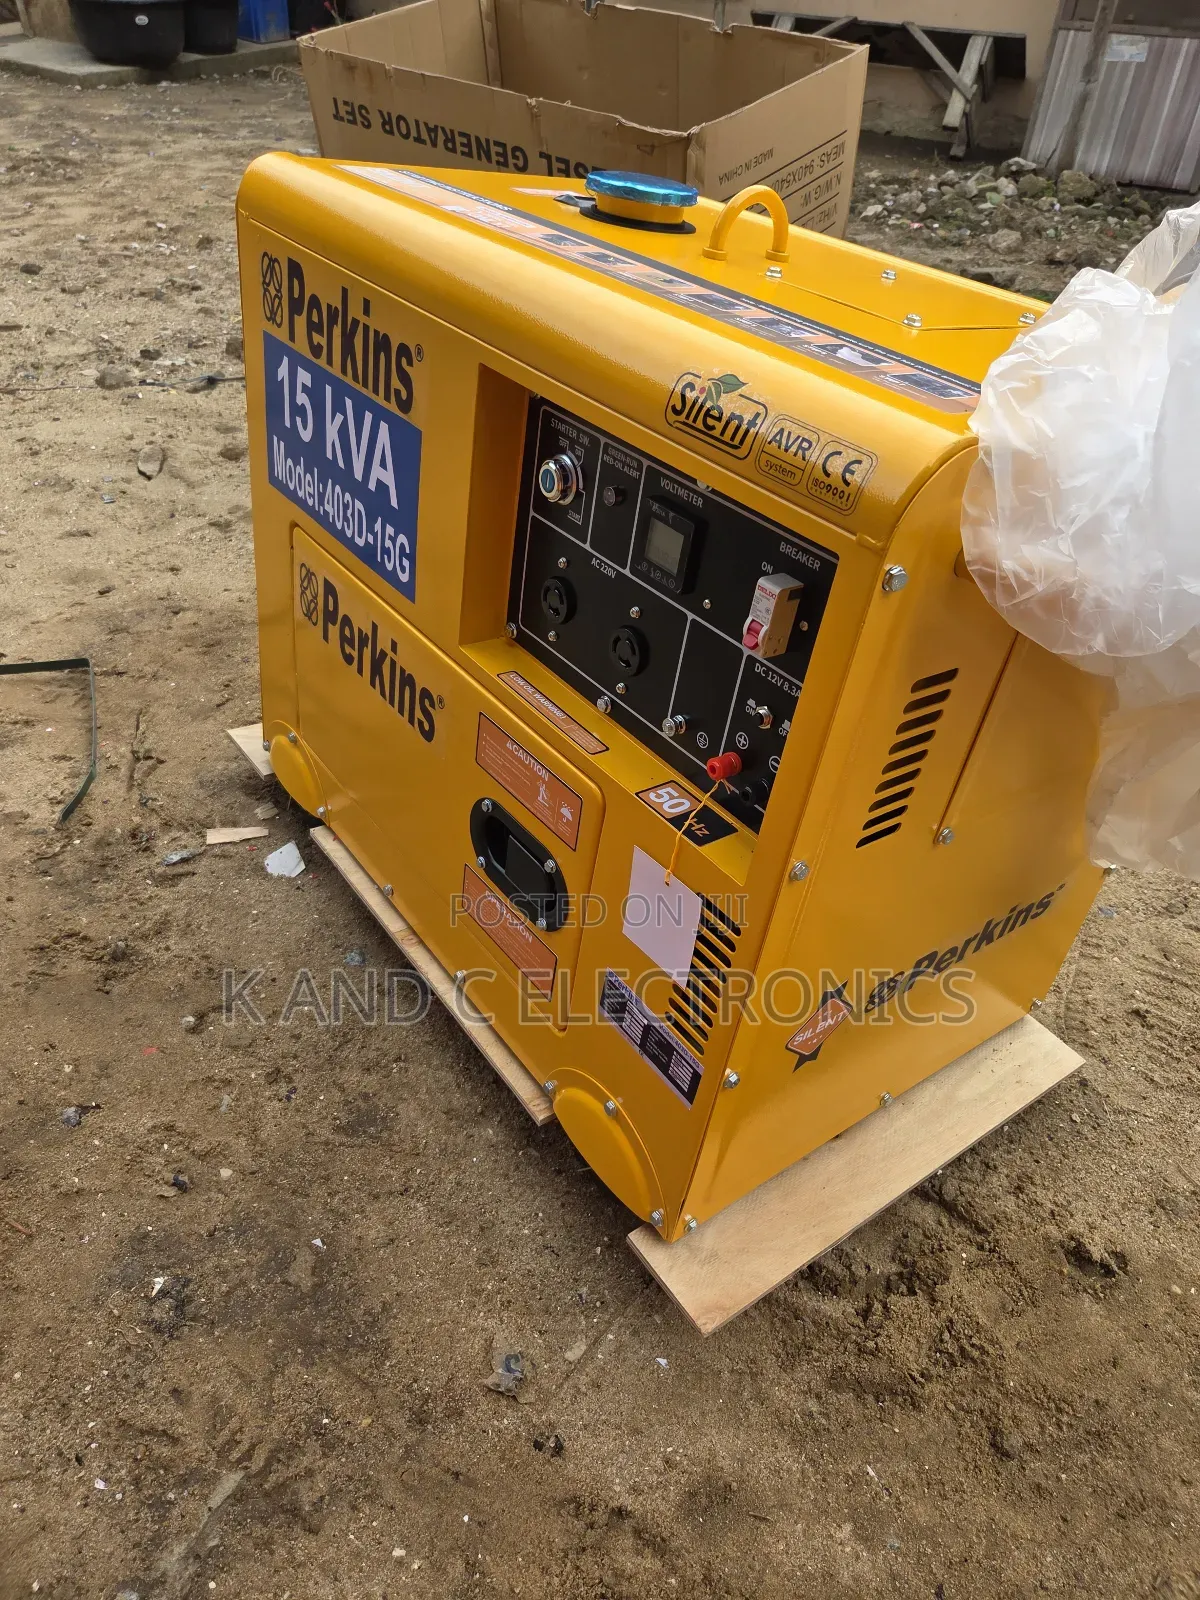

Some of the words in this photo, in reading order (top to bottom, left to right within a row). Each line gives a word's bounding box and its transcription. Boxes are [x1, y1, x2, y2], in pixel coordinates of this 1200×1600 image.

[332, 96, 372, 129] SET
[379, 108, 529, 173] GENERATOR
[744, 161, 752, 173] IN
[753, 147, 774, 169] MADE
[816, 140, 846, 169] MEAS:
[718, 165, 743, 186] CHINA
[671, 381, 762, 448] Silent
[277, 354, 314, 444] 15
[324, 384, 399, 510] kVA
[551, 418, 577, 439] STARTER
[768, 427, 813, 462] AVR
[623, 464, 640, 480] ALERT
[764, 457, 797, 481] system
[822, 450, 862, 488] CE
[660, 477, 703, 508] VOLTMETER
[812, 477, 851, 502] ISO9001
[272, 434, 411, 583] Model:403D-15G
[591, 557, 601, 571] AC
[601, 562, 617, 579] 220V
[761, 561, 773, 574] ON
[779, 541, 821, 572] BREAKER
[510, 673, 526, 686] LOW
[755, 662, 766, 677] DC
[767, 671, 783, 687] 12V
[745, 705, 756, 716] ON
[512, 745, 549, 781] CAUTION
[649, 787, 691, 813] 50
[684, 818, 710, 837] Hz
[794, 1010, 847, 1045] SILENT
